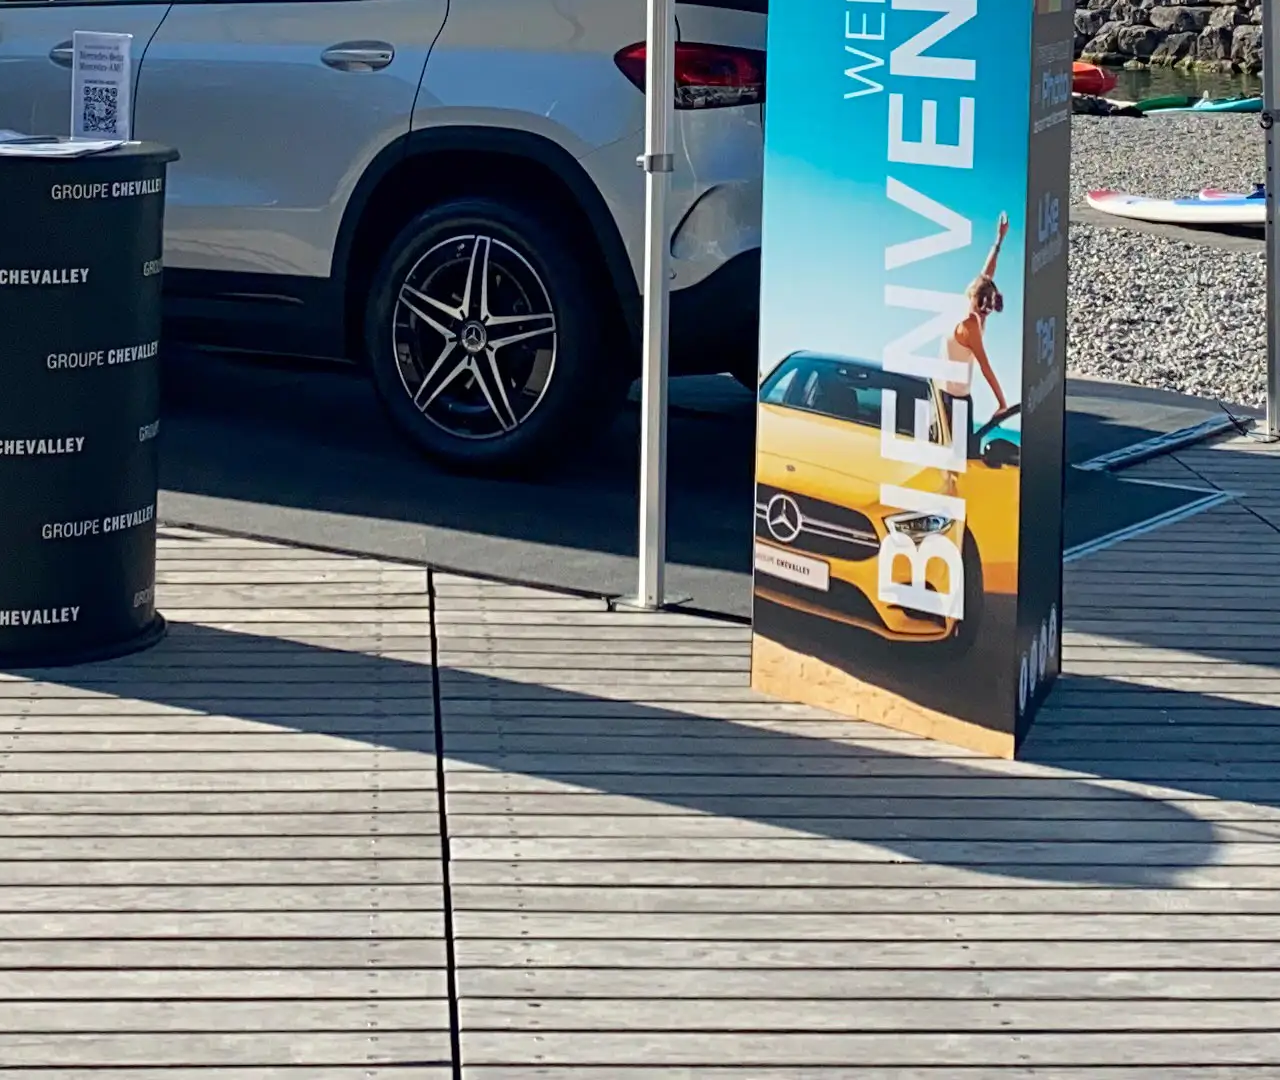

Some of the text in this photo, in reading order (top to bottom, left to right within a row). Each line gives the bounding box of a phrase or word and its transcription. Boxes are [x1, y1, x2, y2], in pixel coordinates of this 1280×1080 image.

[51, 182, 109, 200] GROUPE
[46, 340, 160, 370] GROUPE CHEVALLEY
[41, 503, 155, 540] GROUPE CHEVALLEY
